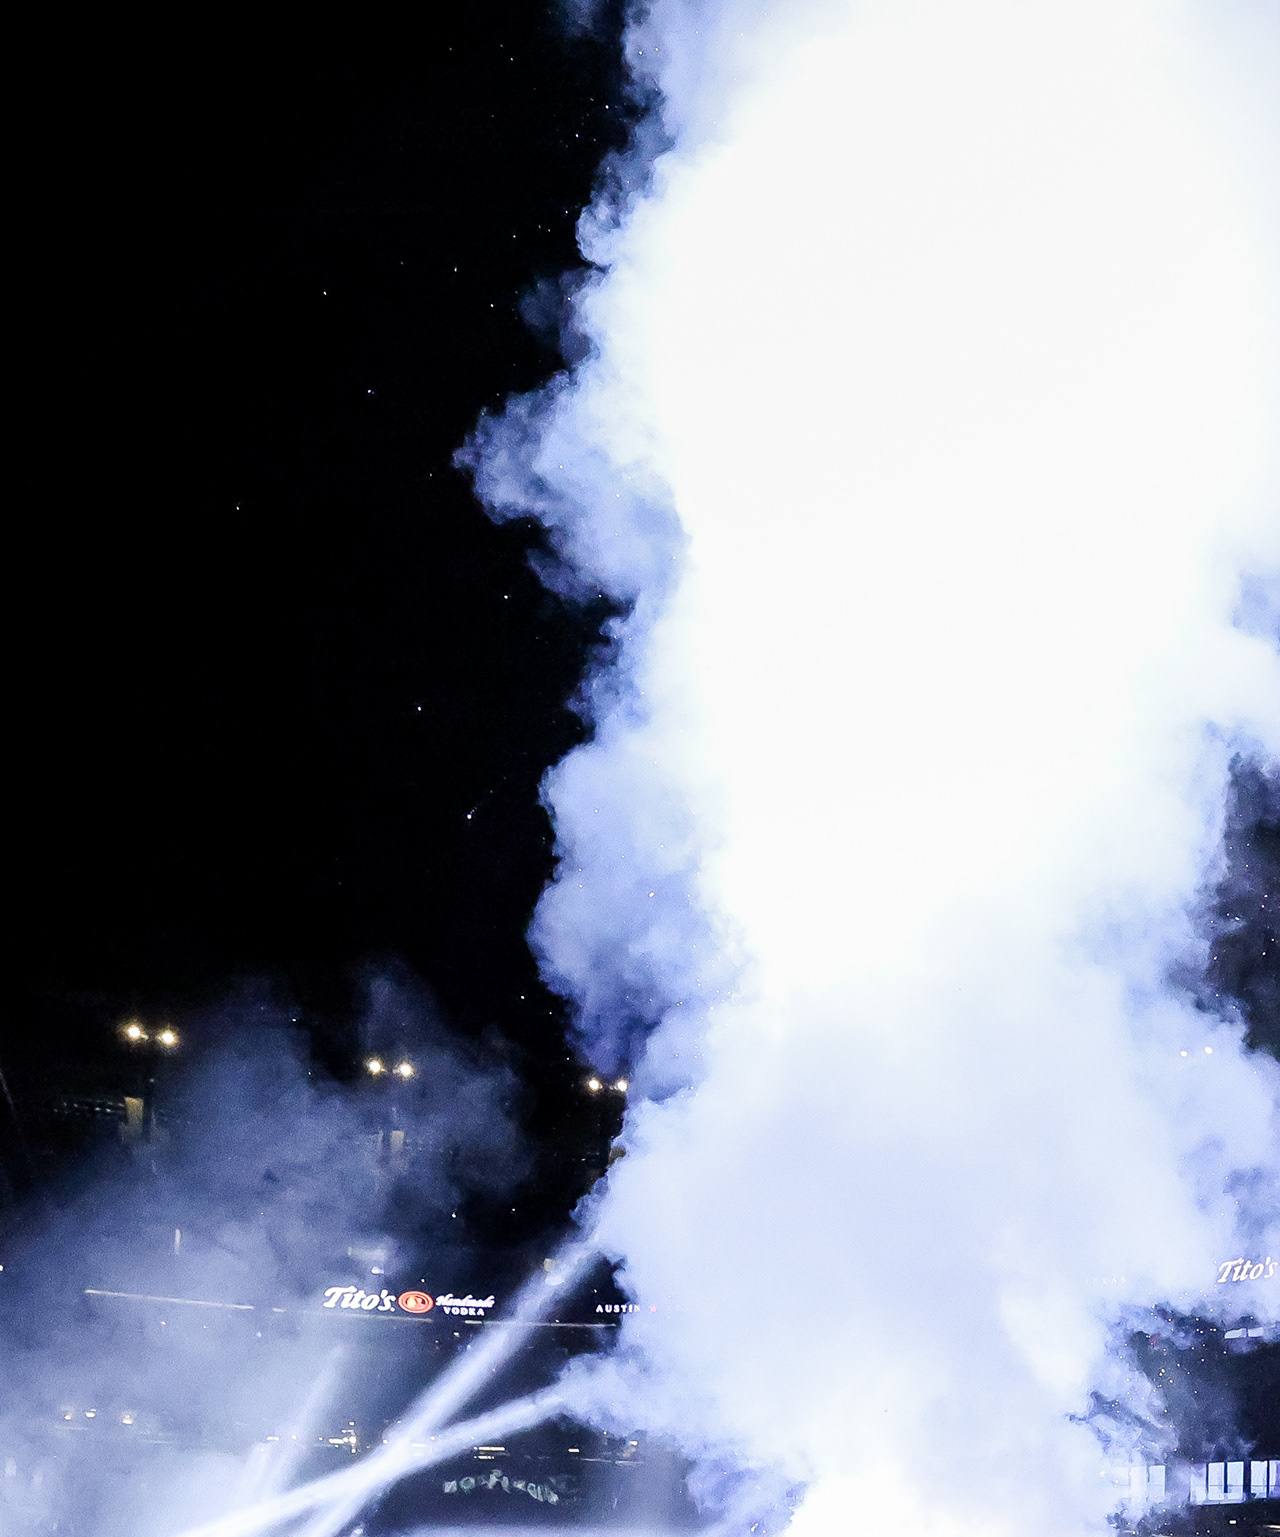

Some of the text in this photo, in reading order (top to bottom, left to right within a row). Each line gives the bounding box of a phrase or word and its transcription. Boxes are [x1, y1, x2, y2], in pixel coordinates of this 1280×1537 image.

[1216, 1256, 1279, 1284] Tito's
[322, 1285, 396, 1312] Tito's
[444, 1306, 485, 1316] VODKA
[595, 1304, 641, 1313] AUSTIN
